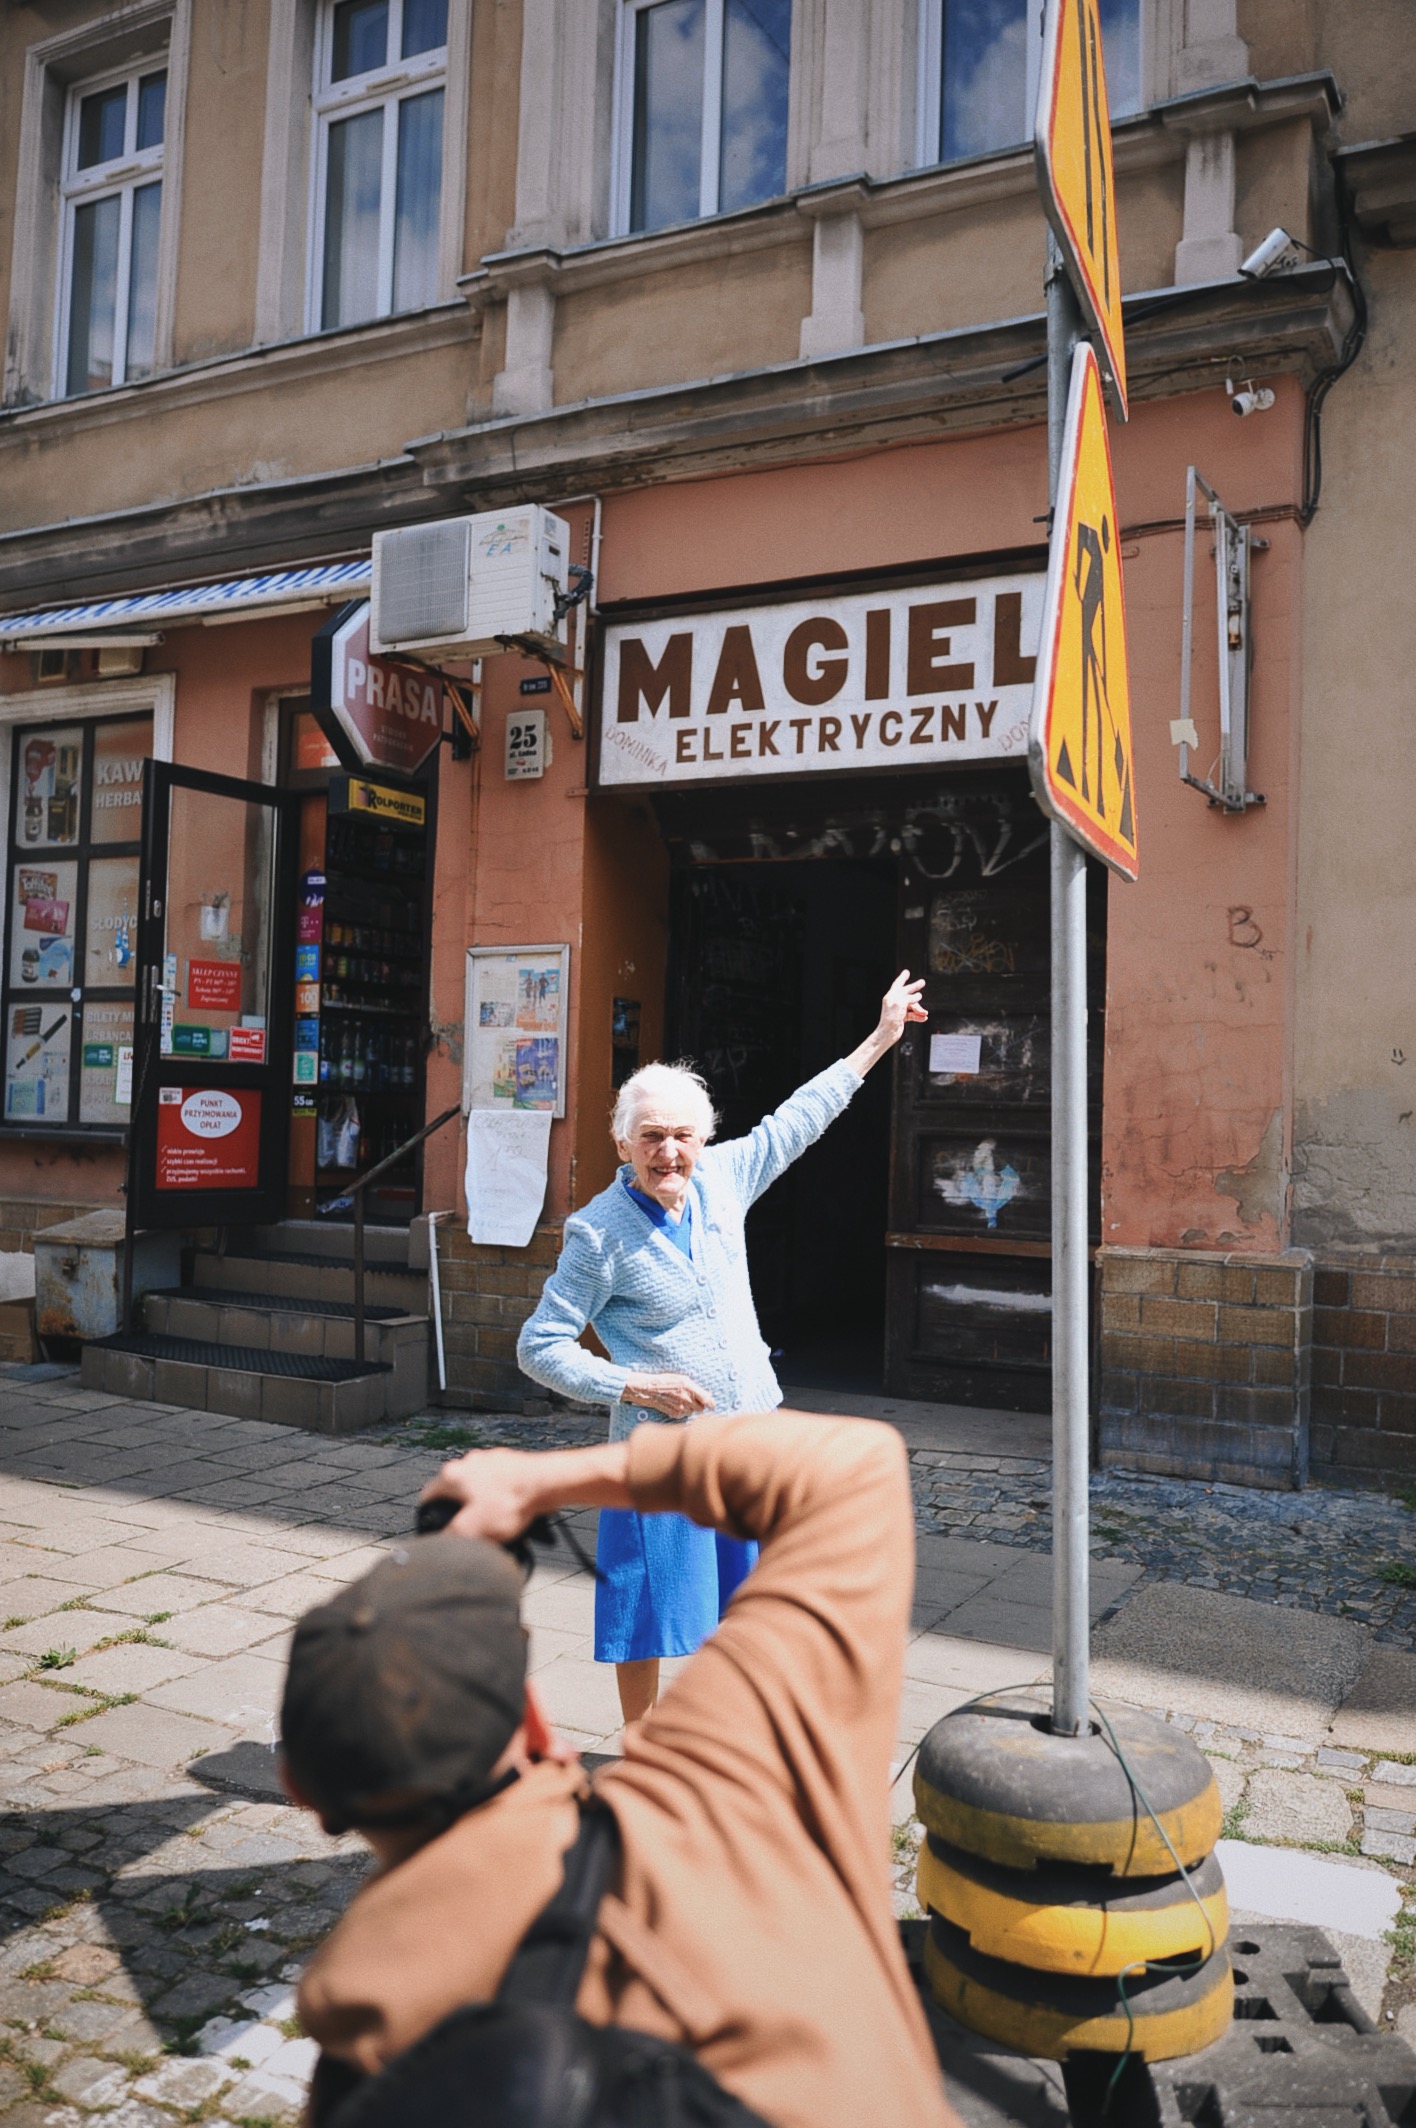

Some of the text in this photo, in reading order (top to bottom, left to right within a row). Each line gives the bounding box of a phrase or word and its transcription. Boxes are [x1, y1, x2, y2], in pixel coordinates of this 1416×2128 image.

[617, 591, 1037, 723] MAGIEL
[347, 658, 438, 727] PRASA
[510, 724, 537, 750] 25
[675, 700, 998, 764] ELEKTRYCZNY
[184, 1109, 238, 1118] PRZYJMOWANIA
[200, 1099, 223, 1107] PUNKT
[200, 1121, 222, 1129] OPŁAT
